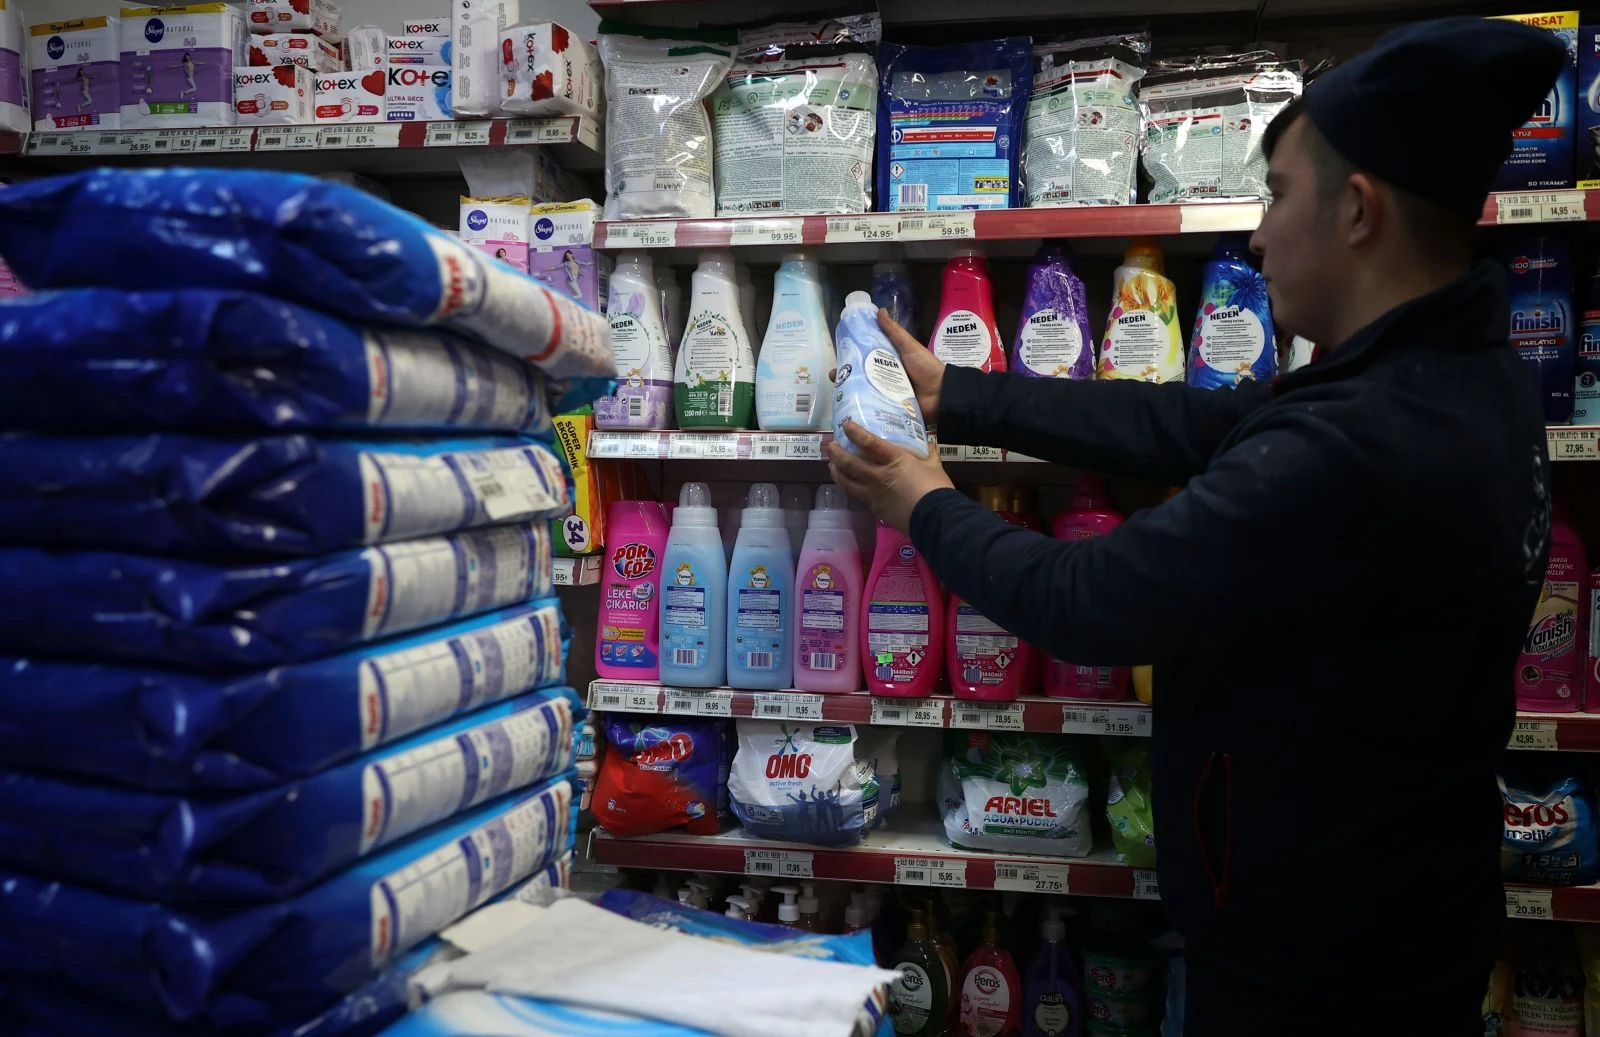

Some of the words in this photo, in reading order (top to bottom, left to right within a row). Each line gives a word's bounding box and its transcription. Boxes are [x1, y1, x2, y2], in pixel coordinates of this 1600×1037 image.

[165, 25, 195, 34] NATURAL
[66, 40, 92, 49] NATURAL
[387, 67, 451, 88] Kote
[1551, 206, 1568, 217] 14,95
[490, 217, 520, 226] NATURAL
[555, 223, 583, 231] NATURAL
[1030, 313, 1058, 324] NEDEN
[1118, 314, 1146, 325] NEDEN
[1210, 310, 1239, 321] NEDEN
[1512, 310, 1561, 331] finish
[611, 319, 633, 330] NEDEN
[697, 319, 712, 329] NEDEN
[775, 319, 803, 330] NEDEN
[946, 323, 977, 335] NEDEN
[874, 357, 899, 369] NEDEN
[565, 420, 581, 451] SÜPER
[556, 421, 579, 470] EKONOMİK
[710, 445, 726, 453] 24,95
[793, 445, 809, 454] 24,95
[1565, 444, 1584, 454] 27,95
[972, 447, 989, 457] 24,95
[567, 520, 585, 545] 34
[613, 542, 648, 562] POR
[902, 548, 914, 556] ABC
[624, 556, 655, 579] ÇÖZ
[607, 590, 632, 600] LEKE
[606, 601, 649, 612] ÇIKARICI
[633, 697, 646, 706] 15,25
[705, 702, 719, 711] 19,95
[795, 706, 809, 715] 11,95
[914, 711, 931, 721] 28,95
[995, 715, 1011, 724] 28,95
[1515, 734, 1534, 745] 42,95
[765, 753, 811, 779] OMO
[787, 779, 803, 787] fresh
[984, 796, 1057, 818] ARIEL
[1503, 801, 1569, 827] eros
[1506, 829, 1552, 842] matik
[786, 864, 800, 873] 17,95
[938, 872, 952, 881] 15,95
[904, 973, 924, 986] eros
[974, 974, 1001, 989] Peros
